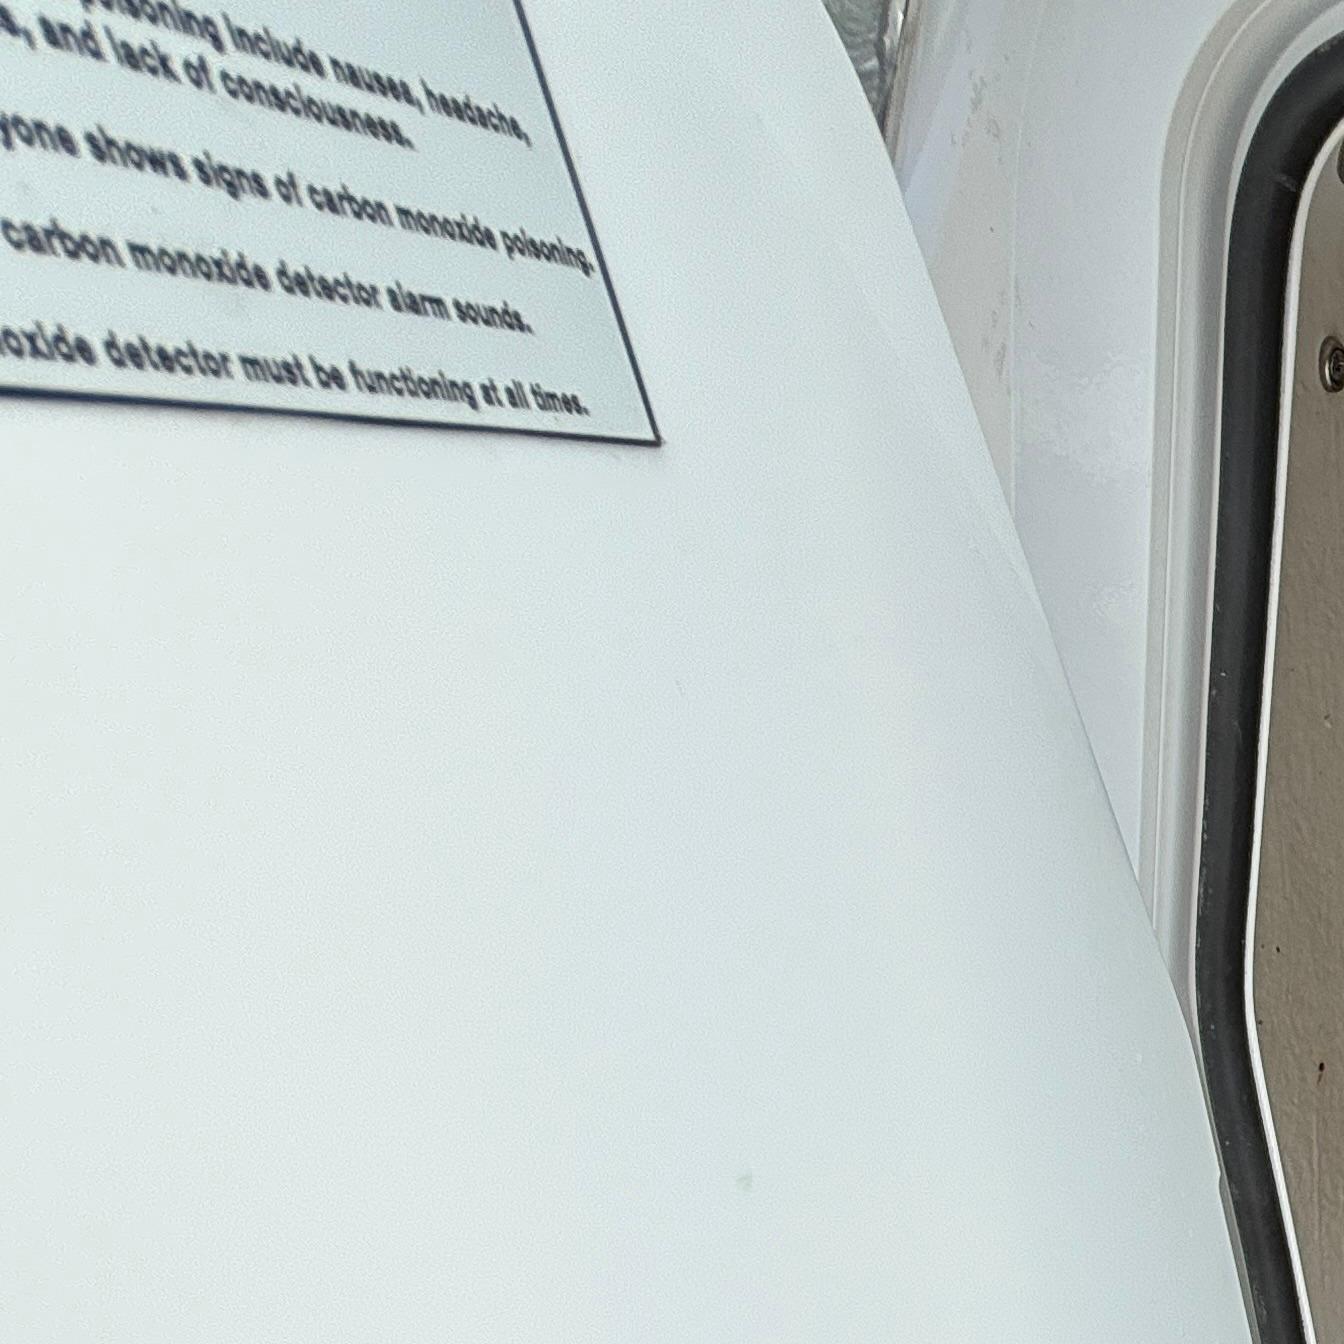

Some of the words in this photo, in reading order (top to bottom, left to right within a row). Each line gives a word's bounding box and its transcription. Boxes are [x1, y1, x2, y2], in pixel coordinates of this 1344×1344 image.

[37, 15, 107, 62] and
[103, 24, 182, 84] lack
[182, 53, 217, 94] of
[218, 68, 416, 150] consciousness.
[220, 11, 326, 79] include
[327, 54, 425, 115] nausea,
[418, 75, 532, 148] headache,
[83, 122, 190, 182] shows
[191, 149, 270, 202] signs
[273, 168, 304, 207] of
[306, 182, 394, 227] carbon
[393, 203, 498, 251] monoxide
[499, 227, 596, 278] poisoning.
[0, 216, 127, 269] carbon
[125, 238, 273, 292] monoxide
[274, 257, 382, 310] detector
[385, 279, 451, 321] alarm
[451, 298, 535, 334] sounds.
[102, 328, 235, 379] detector
[237, 351, 311, 388] must
[307, 354, 347, 392] be
[347, 358, 479, 411] functioning
[479, 377, 505, 409] at
[503, 378, 531, 410] all
[529, 381, 590, 417] times.
